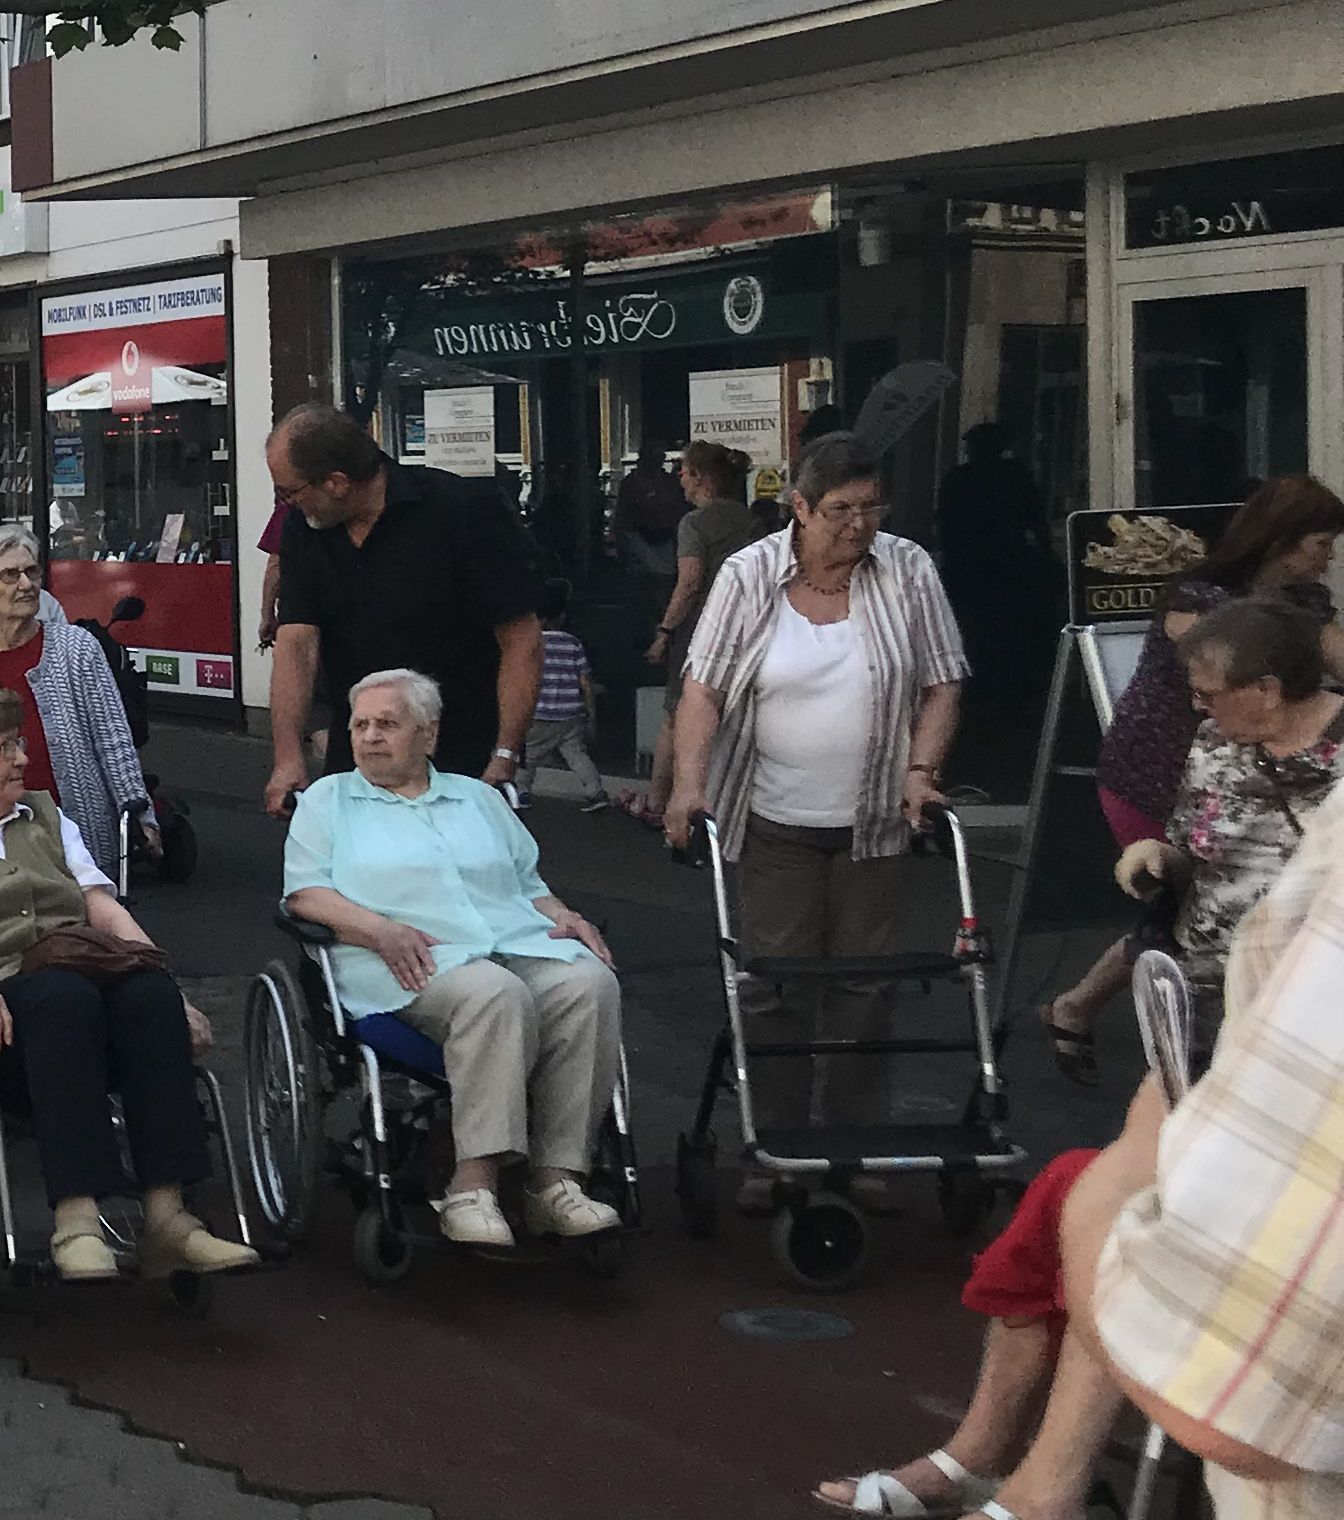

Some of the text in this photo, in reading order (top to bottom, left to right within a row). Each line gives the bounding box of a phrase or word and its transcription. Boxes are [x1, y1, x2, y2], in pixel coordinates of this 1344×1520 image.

[47, 304, 87, 324] MOBILFUNK
[93, 300, 106, 319] DSL
[116, 295, 151, 315] FESTNETZ
[157, 286, 223, 310] TARIFBERATUNG
[113, 385, 150, 401] vodafone
[695, 417, 777, 433] ZU VERMIETEN
[440, 431, 491, 443] VERMIETEN
[1093, 588, 1155, 610] GOLD
